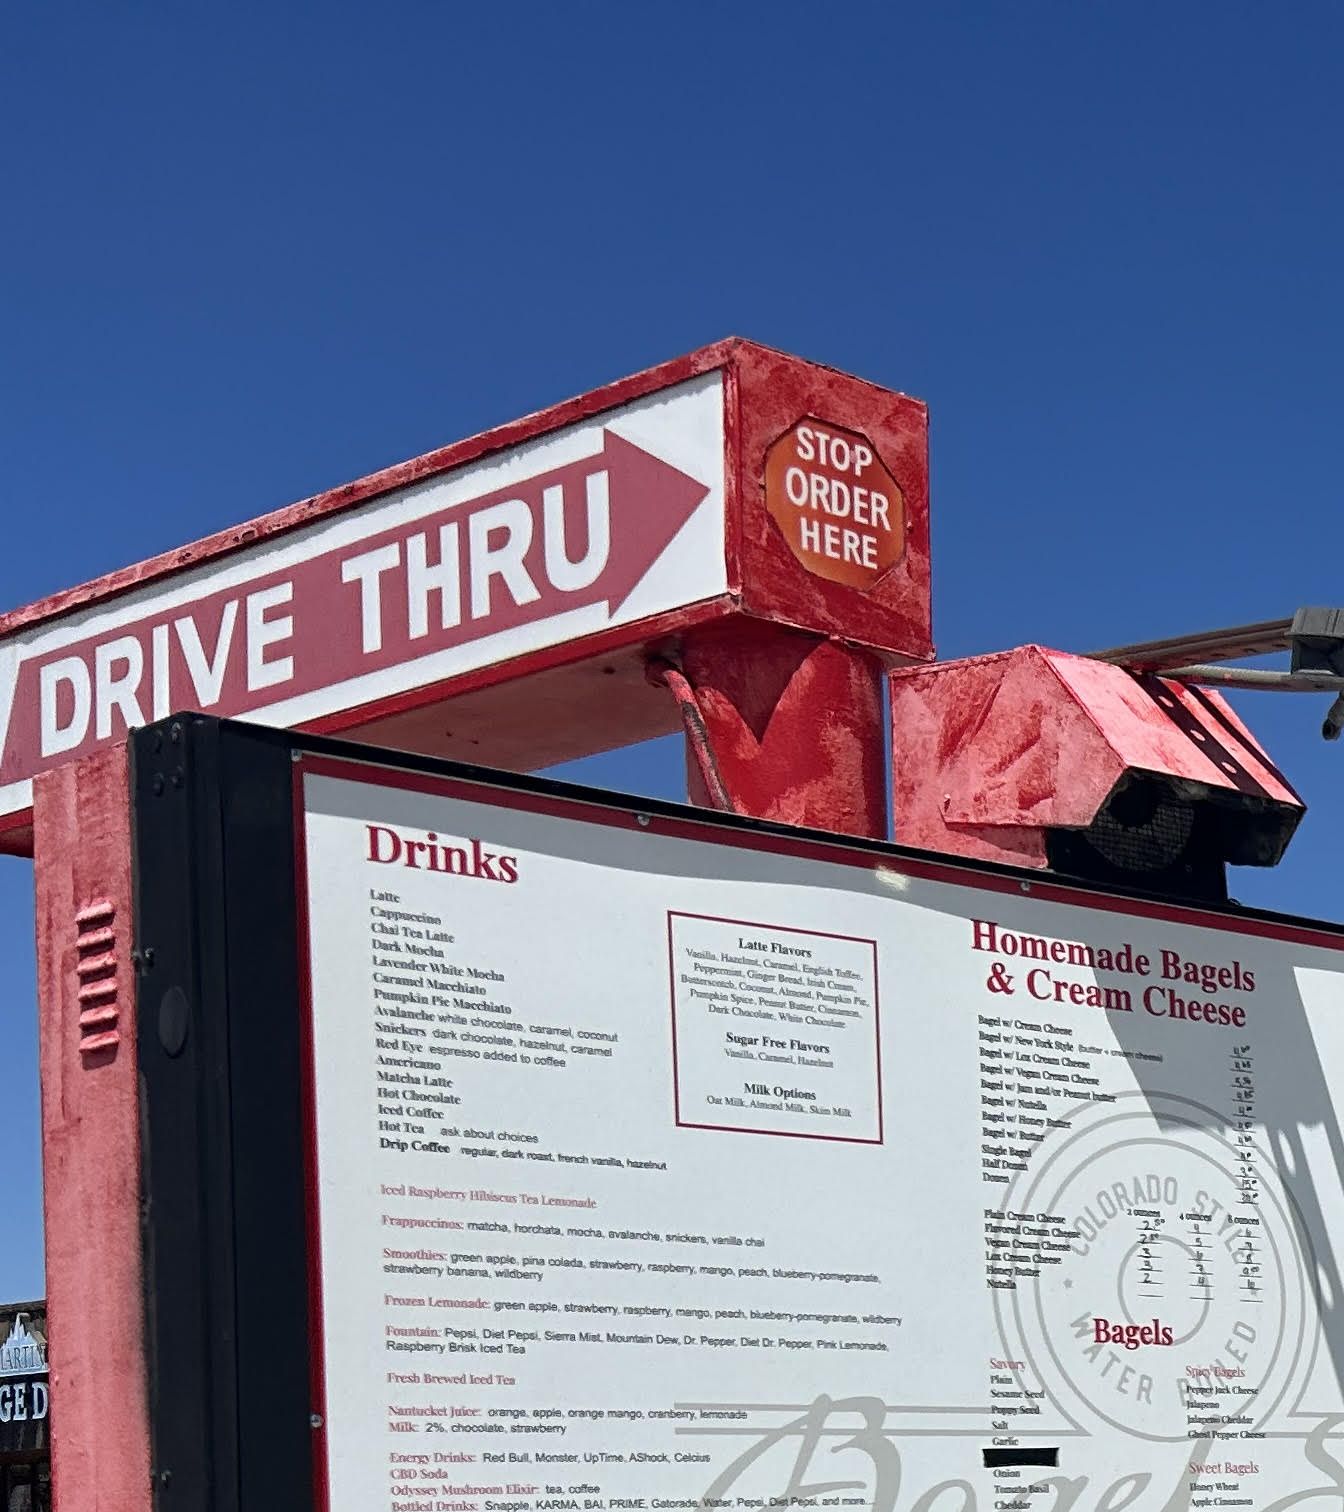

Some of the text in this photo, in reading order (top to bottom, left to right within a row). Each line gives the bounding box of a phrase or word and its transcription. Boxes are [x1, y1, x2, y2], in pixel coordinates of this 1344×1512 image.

[797, 426, 874, 477] STOP
[786, 467, 891, 531] ORDER
[800, 518, 878, 571] HERE
[40, 471, 612, 757] DRIVE THRU
[365, 825, 519, 884] Drinks
[369, 888, 400, 903] Latte
[369, 908, 442, 926] Cappuccino
[370, 922, 455, 943] Chai Tea Latte
[371, 938, 445, 958] Dark Mocha
[738, 937, 812, 958] Latte Flavors
[969, 920, 1255, 991] Homemade Bagels
[986, 963, 1246, 1026] & Cream Cheese
[436, 1013, 468, 1025] white
[576, 1030, 619, 1042] coconut
[375, 1038, 400, 1057] Red
[428, 1046, 481, 1058] espresso
[482, 1050, 518, 1062] added
[519, 1053, 531, 1064] to
[533, 1056, 566, 1067] coffee
[726, 1032, 830, 1054] Sugar Free Flavors
[744, 1082, 817, 1100] Milk Options
[1070, 1174, 1178, 1257] COLORADO
[385, 1340, 446, 1354] Raspberry
[479, 1343, 503, 1354] Iced
[505, 1343, 526, 1354] Tea
[1092, 1318, 1174, 1350] Bagels
[386, 1372, 516, 1385] Fresh Brewed Iced Tea
[1188, 1461, 1259, 1478] Sweet Bagels
